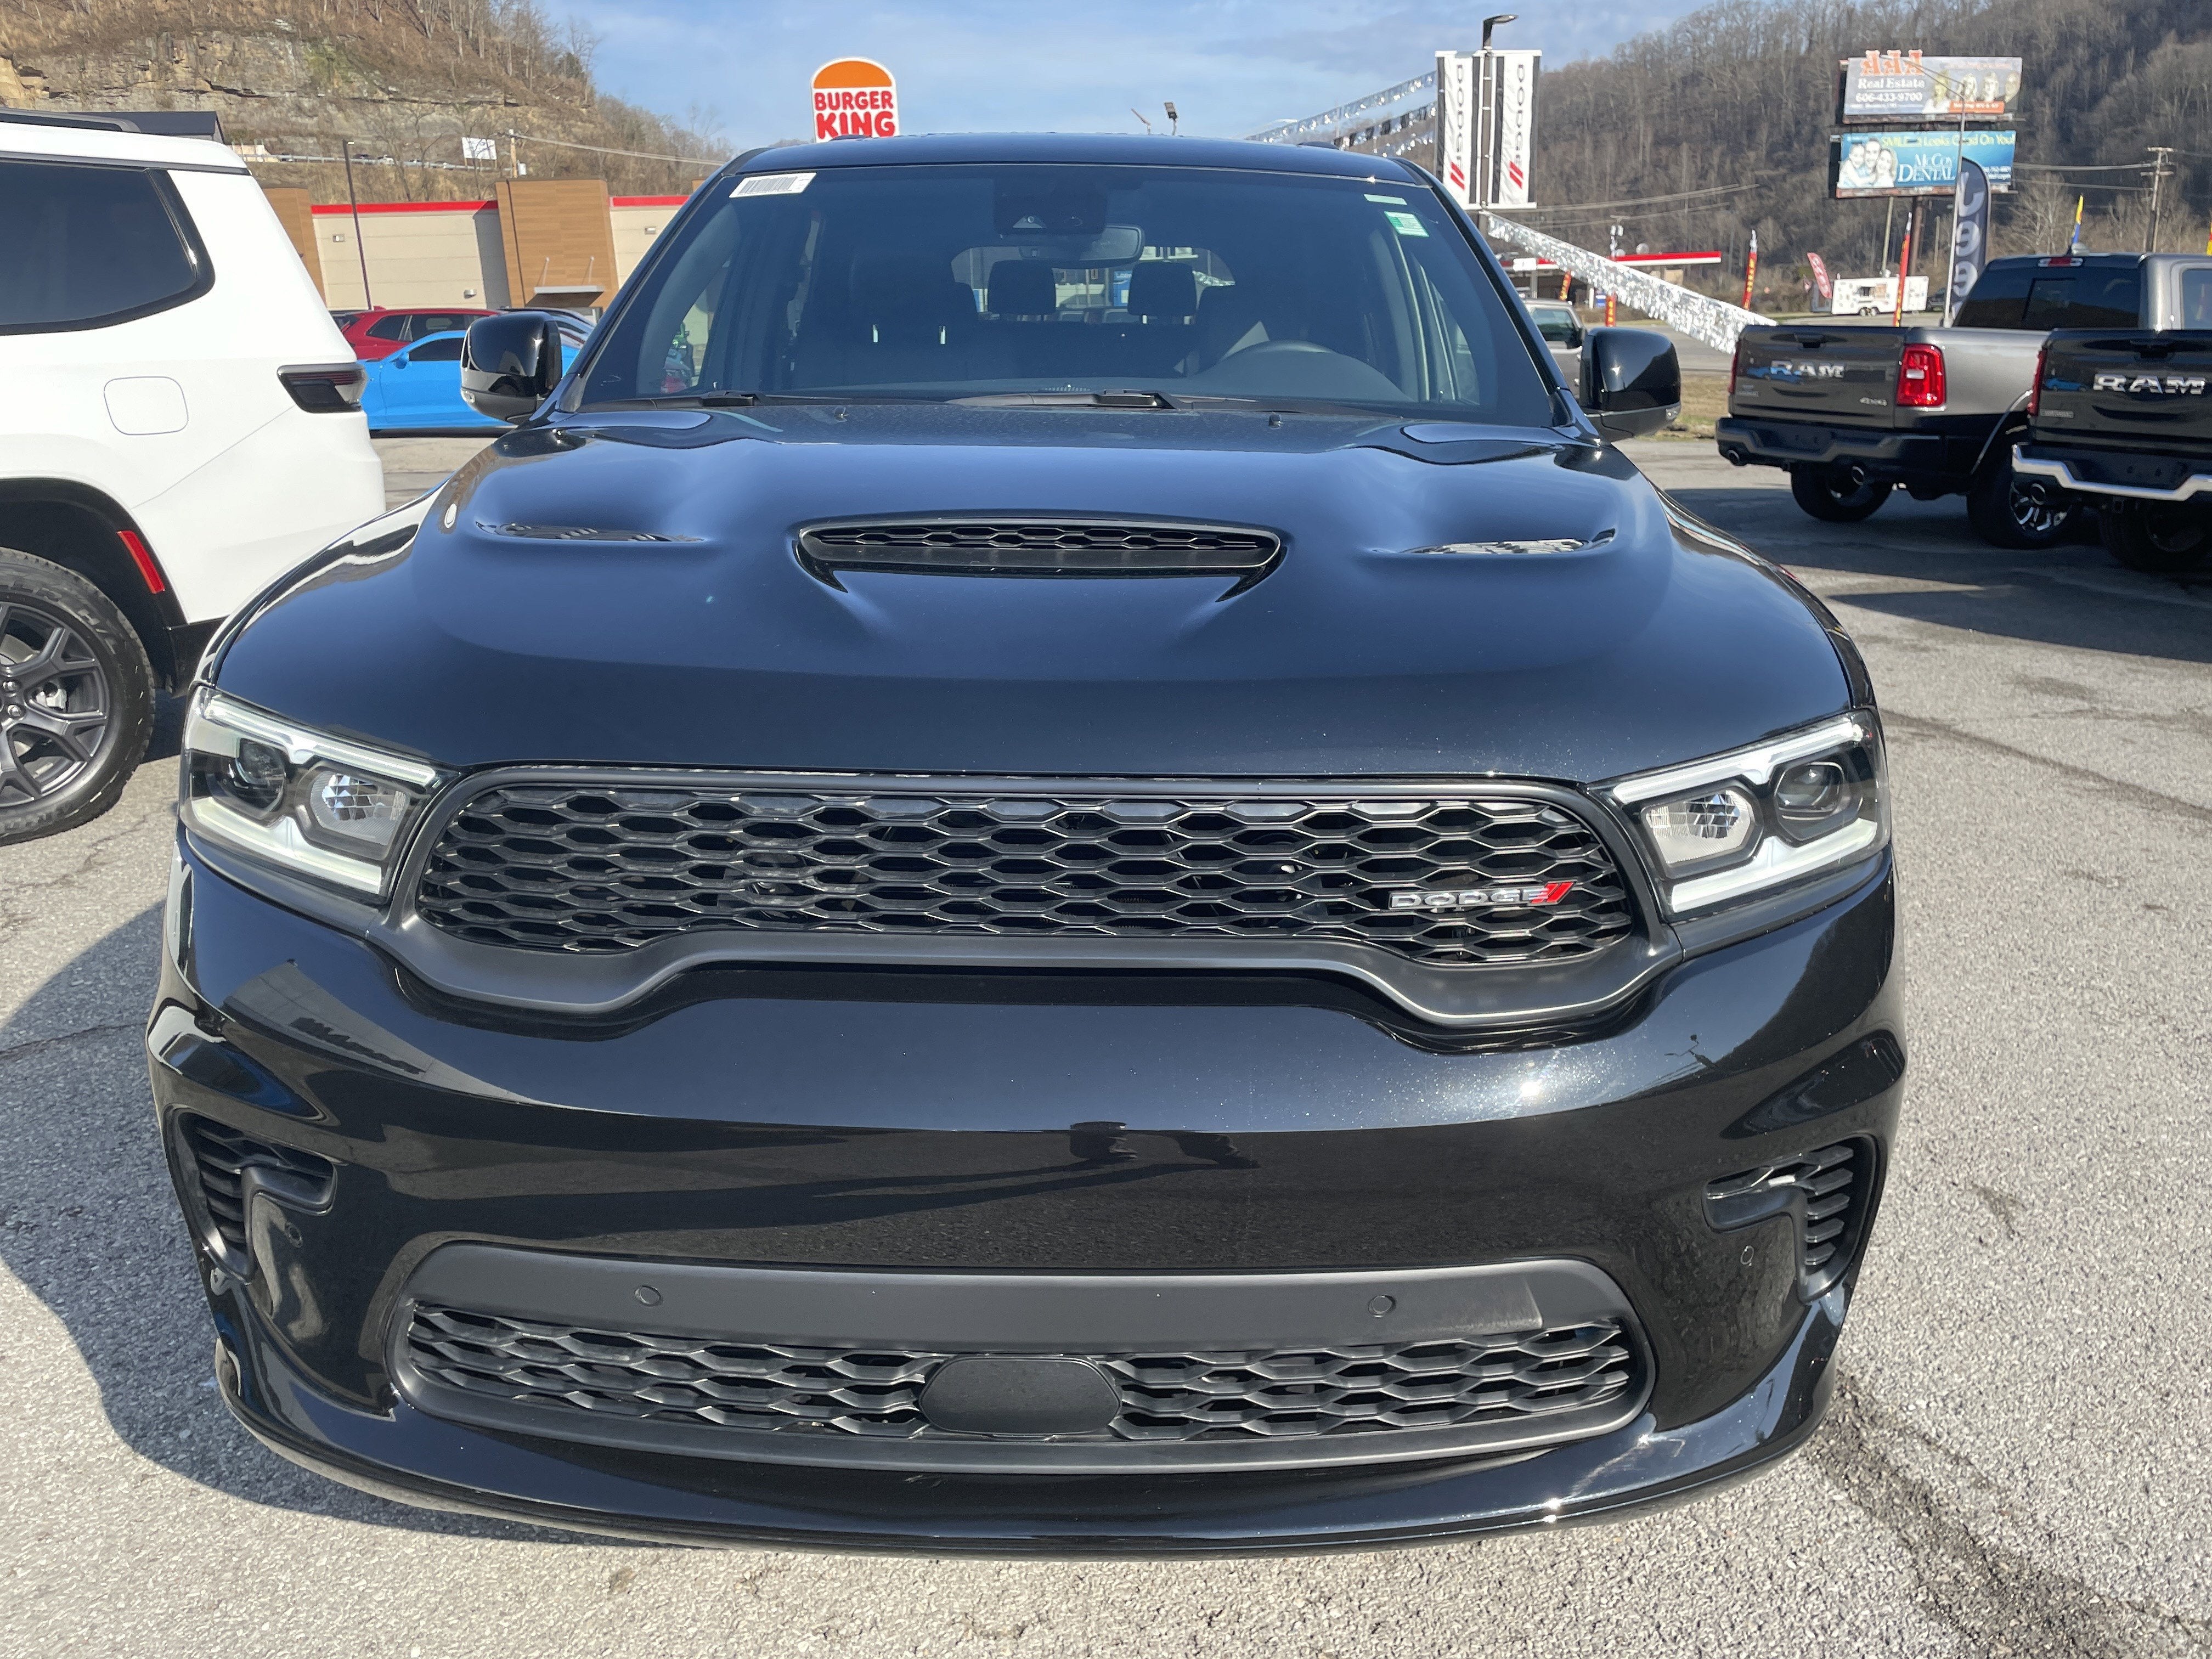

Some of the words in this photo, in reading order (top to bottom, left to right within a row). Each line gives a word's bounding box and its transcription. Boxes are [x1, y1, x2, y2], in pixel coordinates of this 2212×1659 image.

[1858, 78, 1884, 89] Real
[1886, 78, 1925, 88] Estate
[814, 91, 894, 111] BURGER
[815, 112, 895, 138] KING
[1980, 133, 1994, 145] On
[1898, 163, 1956, 182] DENTAL
[1770, 360, 1845, 379] RAM
[2092, 373, 2206, 396] RAM
[1391, 888, 1549, 907] DODGE
